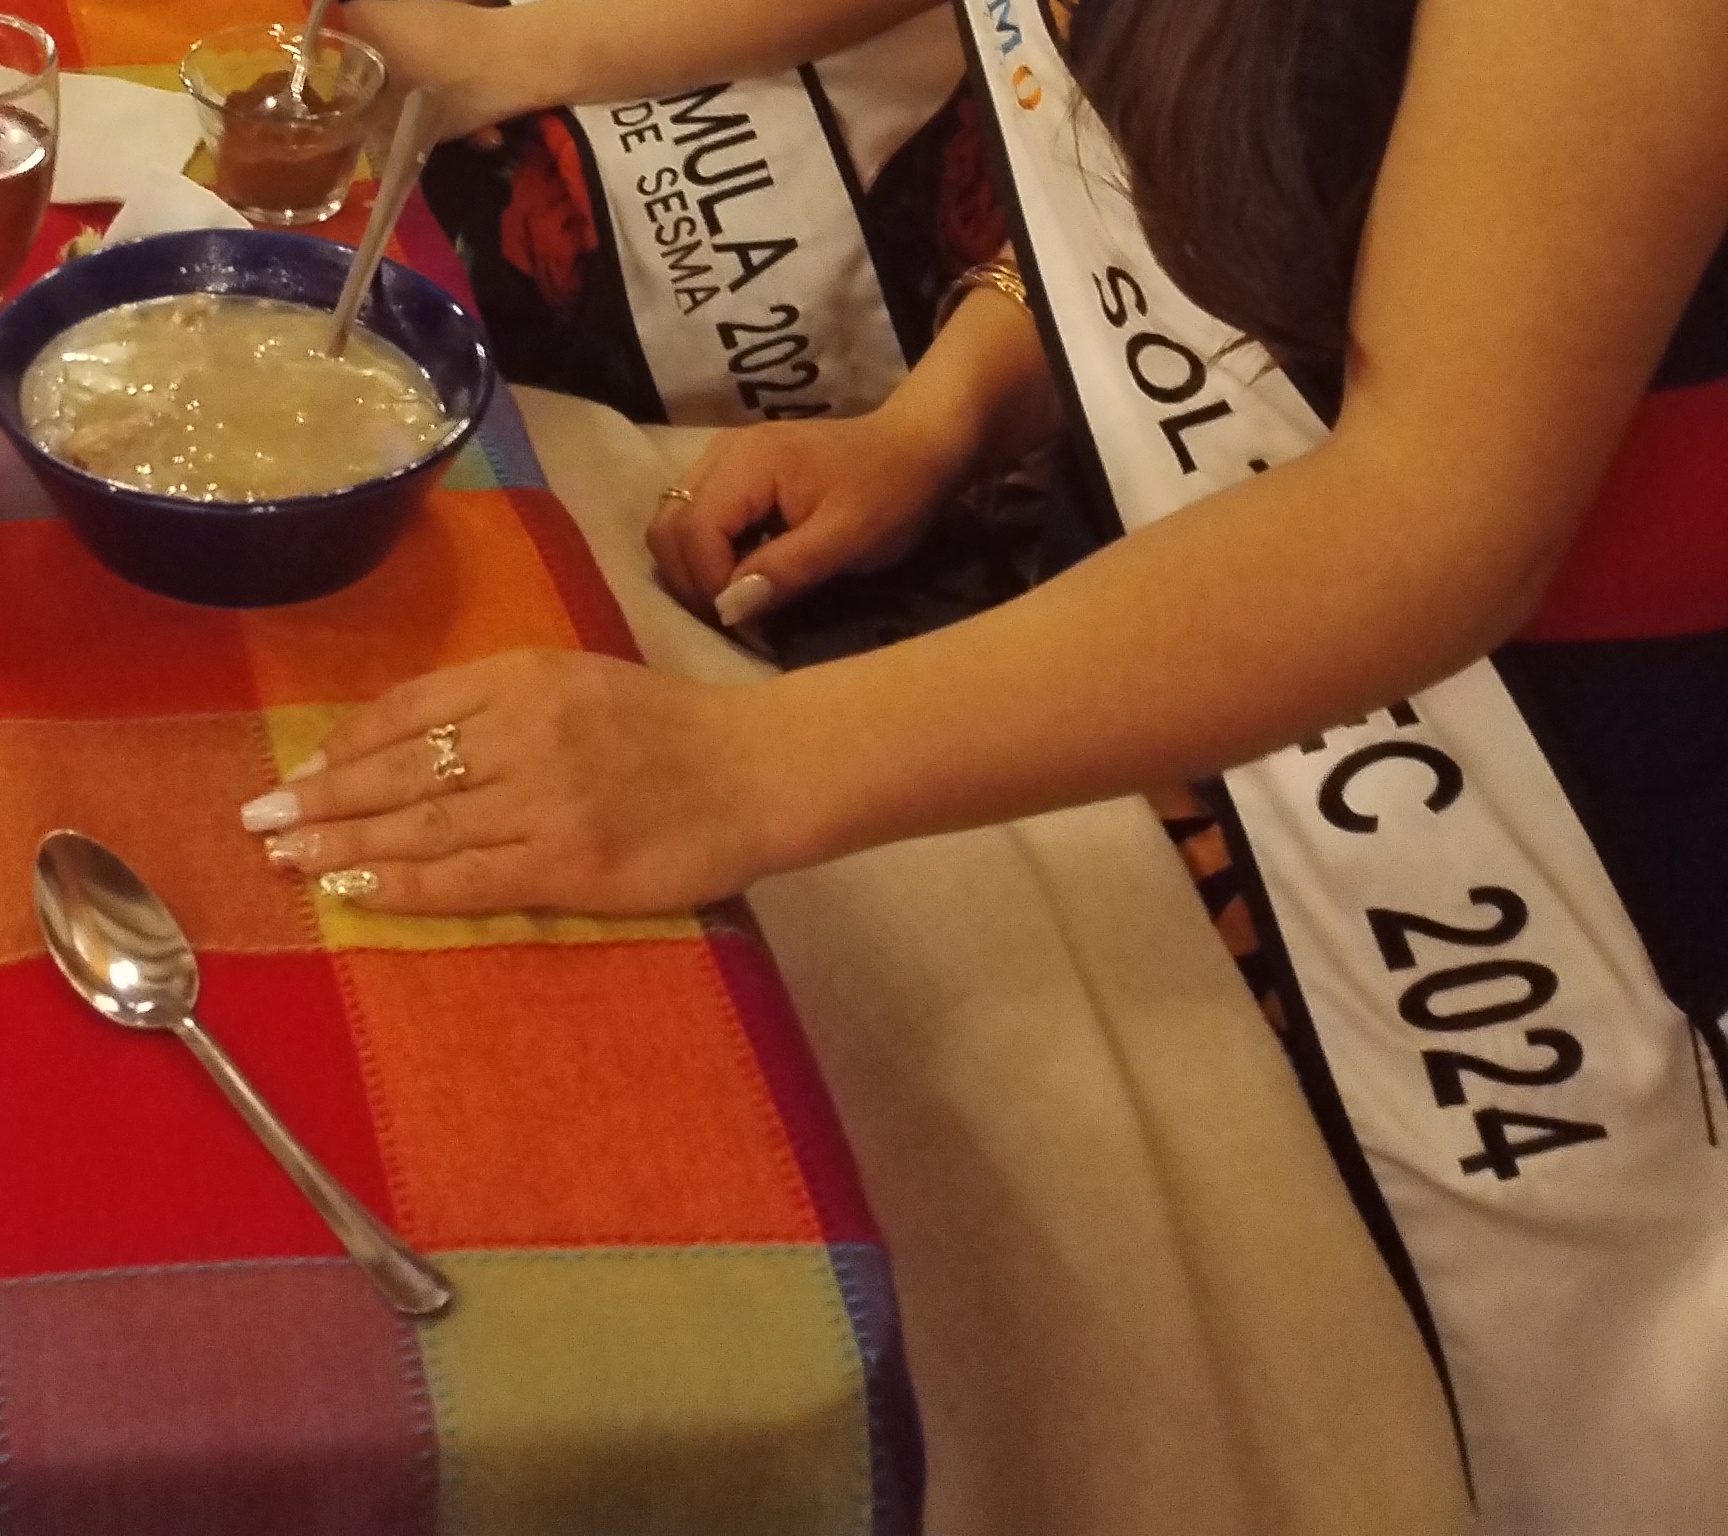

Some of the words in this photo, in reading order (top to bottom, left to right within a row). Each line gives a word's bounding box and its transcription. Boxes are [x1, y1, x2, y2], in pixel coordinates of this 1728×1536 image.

[610, 102, 664, 154] DE
[636, 166, 721, 316] SESMA
[1364, 885, 1608, 1181] 2024
